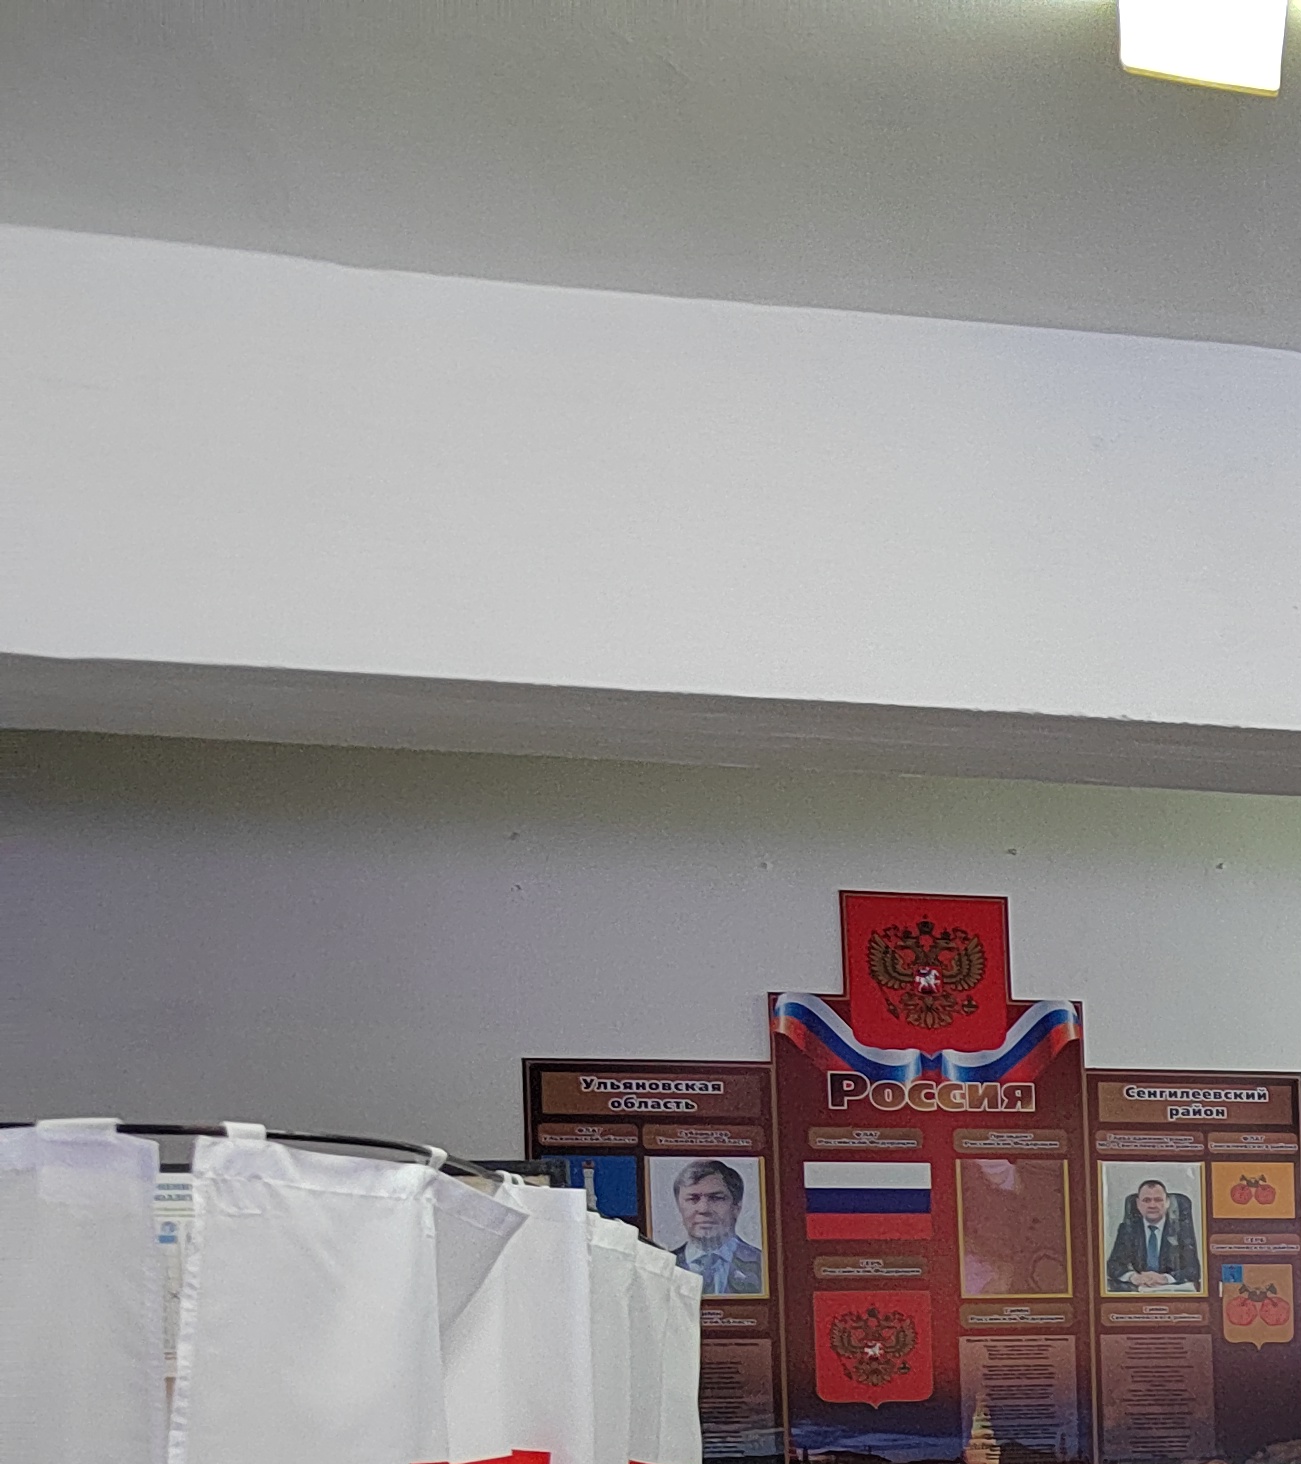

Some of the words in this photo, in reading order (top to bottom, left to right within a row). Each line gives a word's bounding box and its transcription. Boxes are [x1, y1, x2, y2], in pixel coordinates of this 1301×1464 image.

[581, 1076, 724, 1093] Ульяновская
[827, 1070, 1036, 1112] Россия
[1124, 1084, 1269, 1102] Сенгилеевский
[609, 1095, 698, 1112] область
[1168, 1104, 1227, 1121] район
